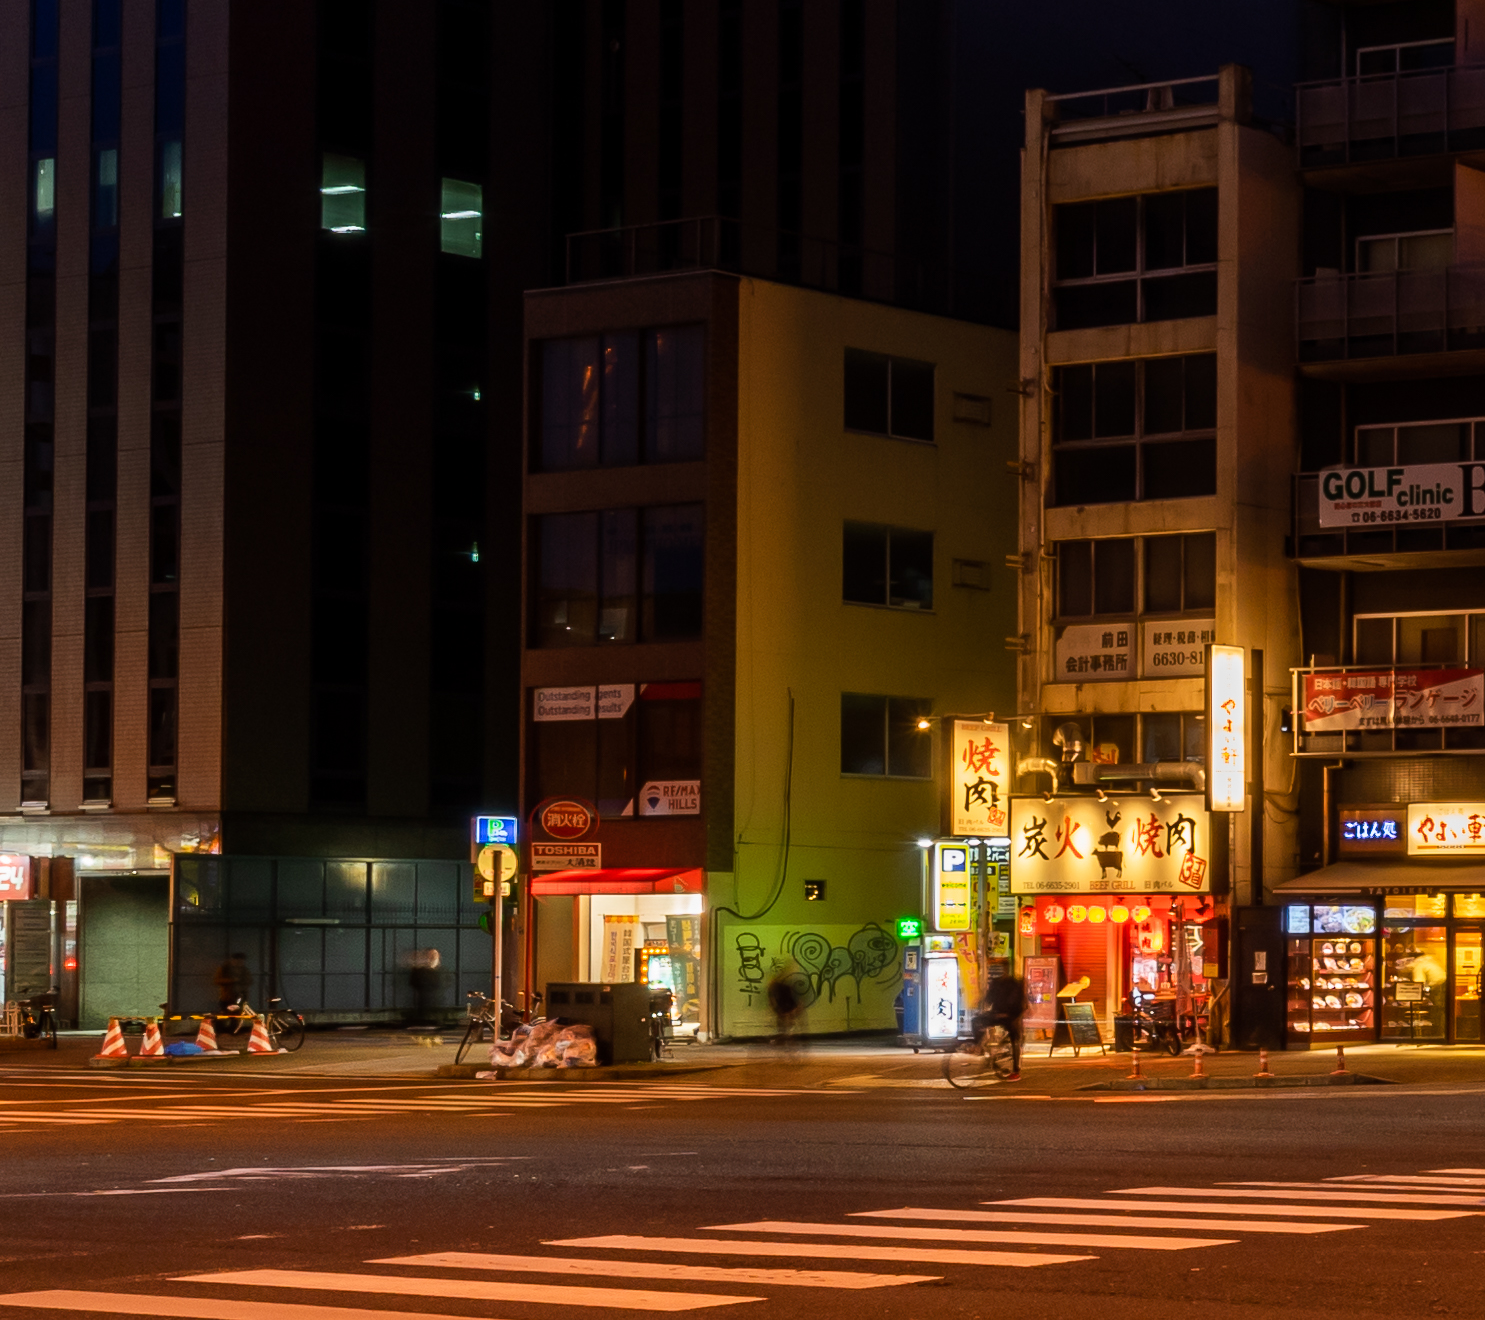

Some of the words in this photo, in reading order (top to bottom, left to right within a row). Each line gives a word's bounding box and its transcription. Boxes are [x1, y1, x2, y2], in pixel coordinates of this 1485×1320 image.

[1323, 469, 1404, 501] GOLF
[1396, 483, 1454, 507] clinic
[1102, 630, 1128, 648] 前田
[1066, 653, 1128, 673] 会計事務所
[538, 690, 591, 702] Outstanding
[598, 689, 622, 702] gents
[538, 704, 591, 717] Outstanding
[962, 737, 1001, 812] 焼肉
[668, 799, 697, 809] HILLS
[547, 812, 586, 828] 消火栓
[1344, 820, 1397, 840] ごはん処
[1018, 815, 1084, 860] 炭火
[1132, 812, 1197, 858] 焼肉
[536, 845, 597, 855] TOSHIBA
[941, 850, 966, 872] P
